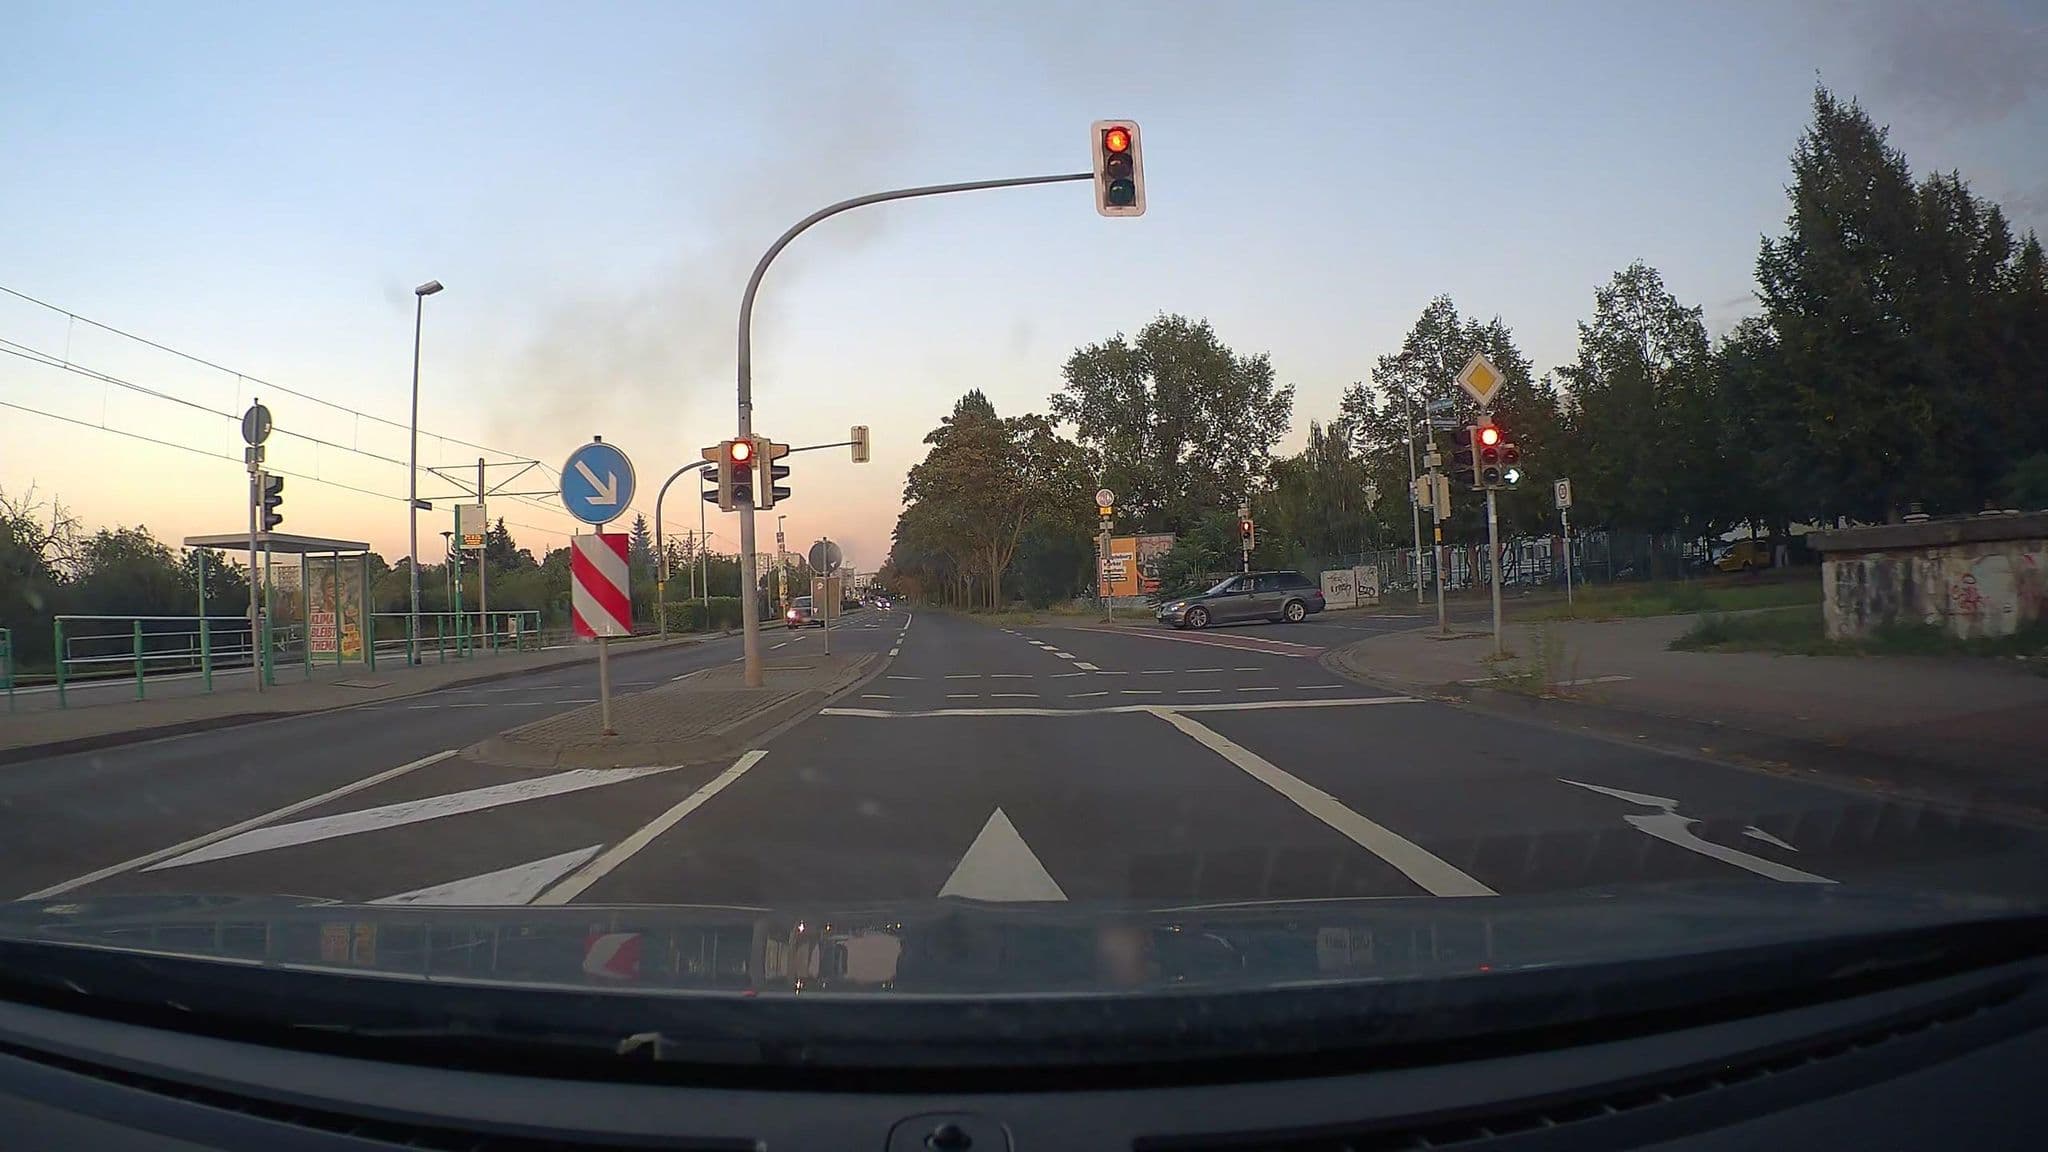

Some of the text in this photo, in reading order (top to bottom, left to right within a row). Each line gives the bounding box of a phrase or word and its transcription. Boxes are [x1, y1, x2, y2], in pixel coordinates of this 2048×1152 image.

[311, 613, 334, 624] KLIMA
[311, 626, 336, 638] BLEIBT
[311, 640, 336, 651] THEMA
